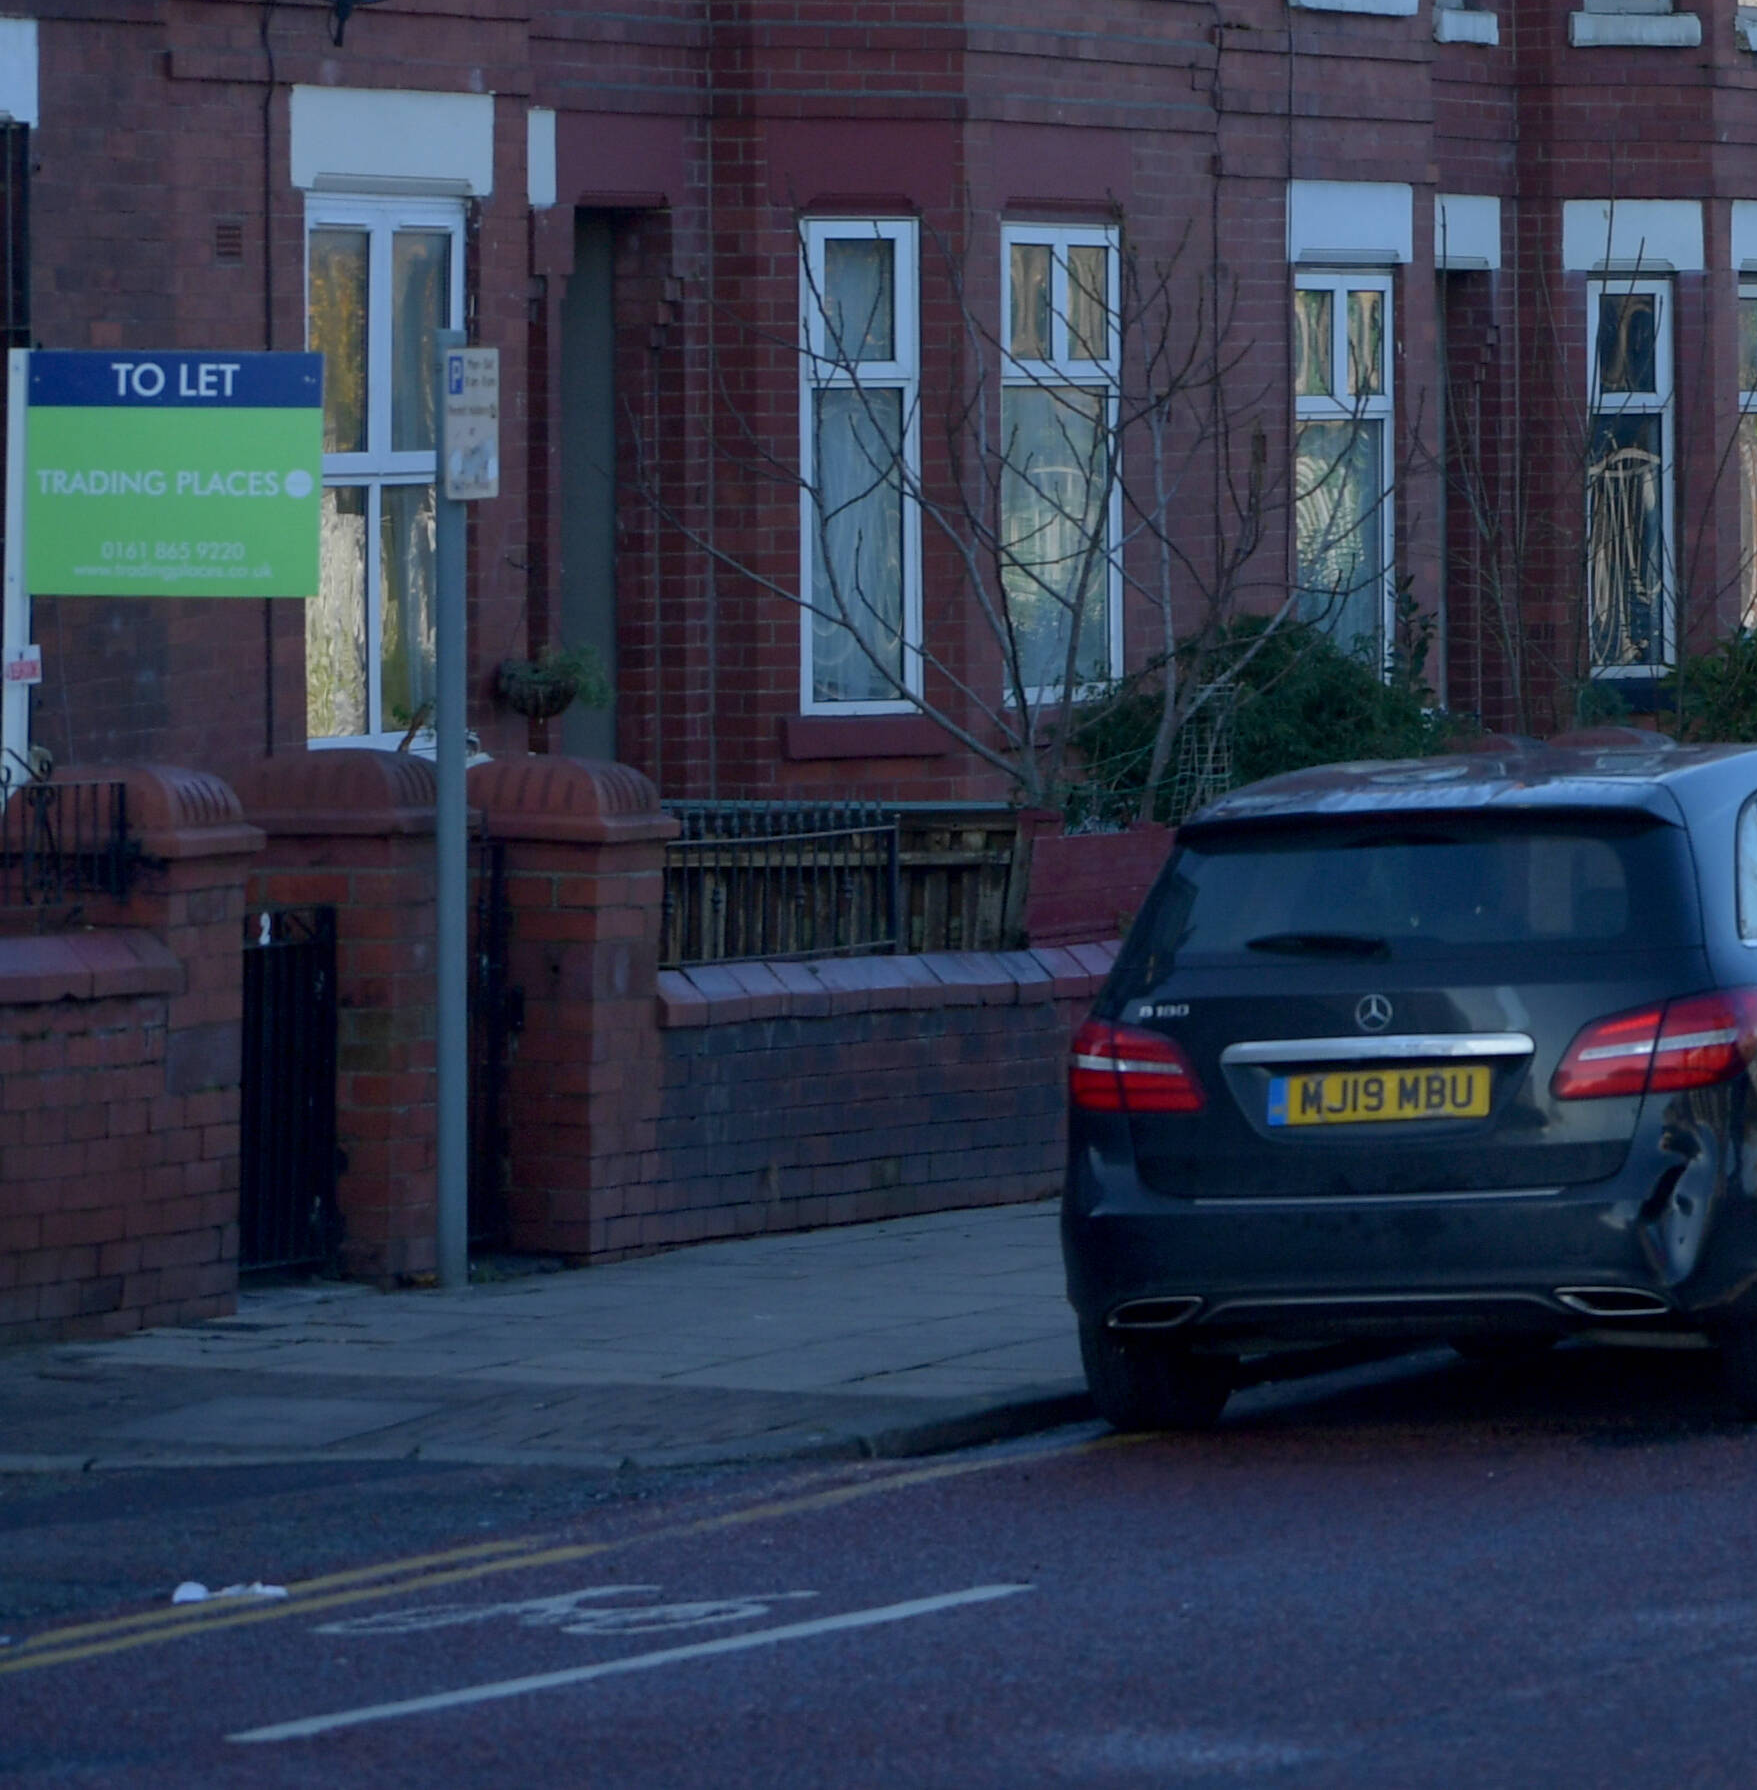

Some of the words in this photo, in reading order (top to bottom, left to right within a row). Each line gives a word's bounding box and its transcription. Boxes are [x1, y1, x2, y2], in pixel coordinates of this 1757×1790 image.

[111, 363, 165, 397] TO
[180, 363, 240, 397] LET
[36, 469, 166, 496] TRADING
[176, 469, 280, 497] PLACES
[102, 542, 147, 561] 0161
[154, 542, 190, 561] 865
[196, 542, 246, 561] 9220
[73, 563, 273, 581] www.tradingplaces.co.uk
[1301, 1077, 1385, 1115] MJ19
[1398, 1075, 1473, 1111] MBU
